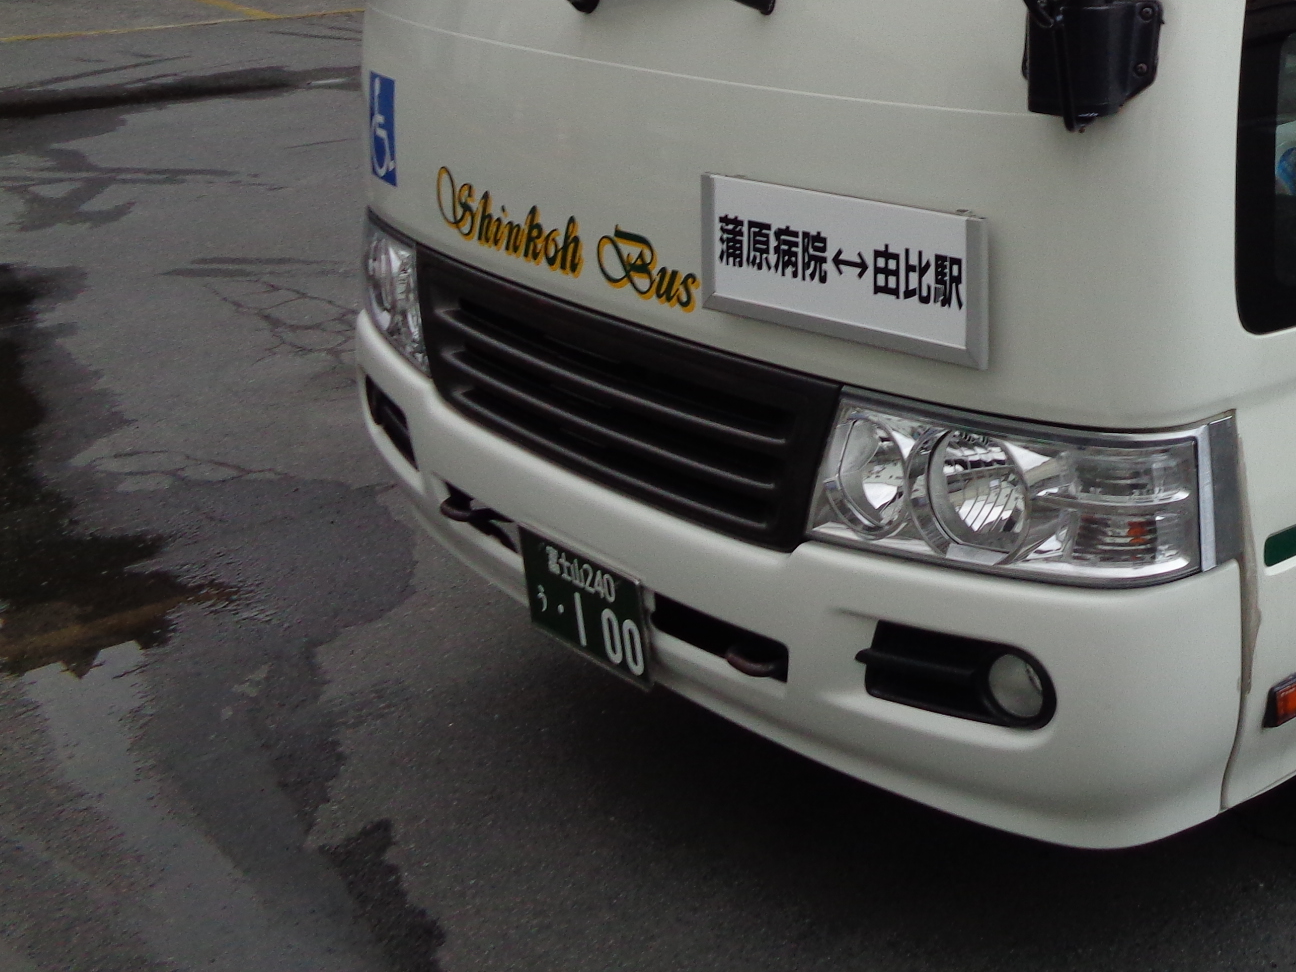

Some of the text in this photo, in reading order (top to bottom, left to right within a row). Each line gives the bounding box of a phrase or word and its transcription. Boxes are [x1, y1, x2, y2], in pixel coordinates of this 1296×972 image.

[437, 166, 700, 313] Shinkoh Bus
[718, 214, 964, 311] 蒲原病院 由比駅
